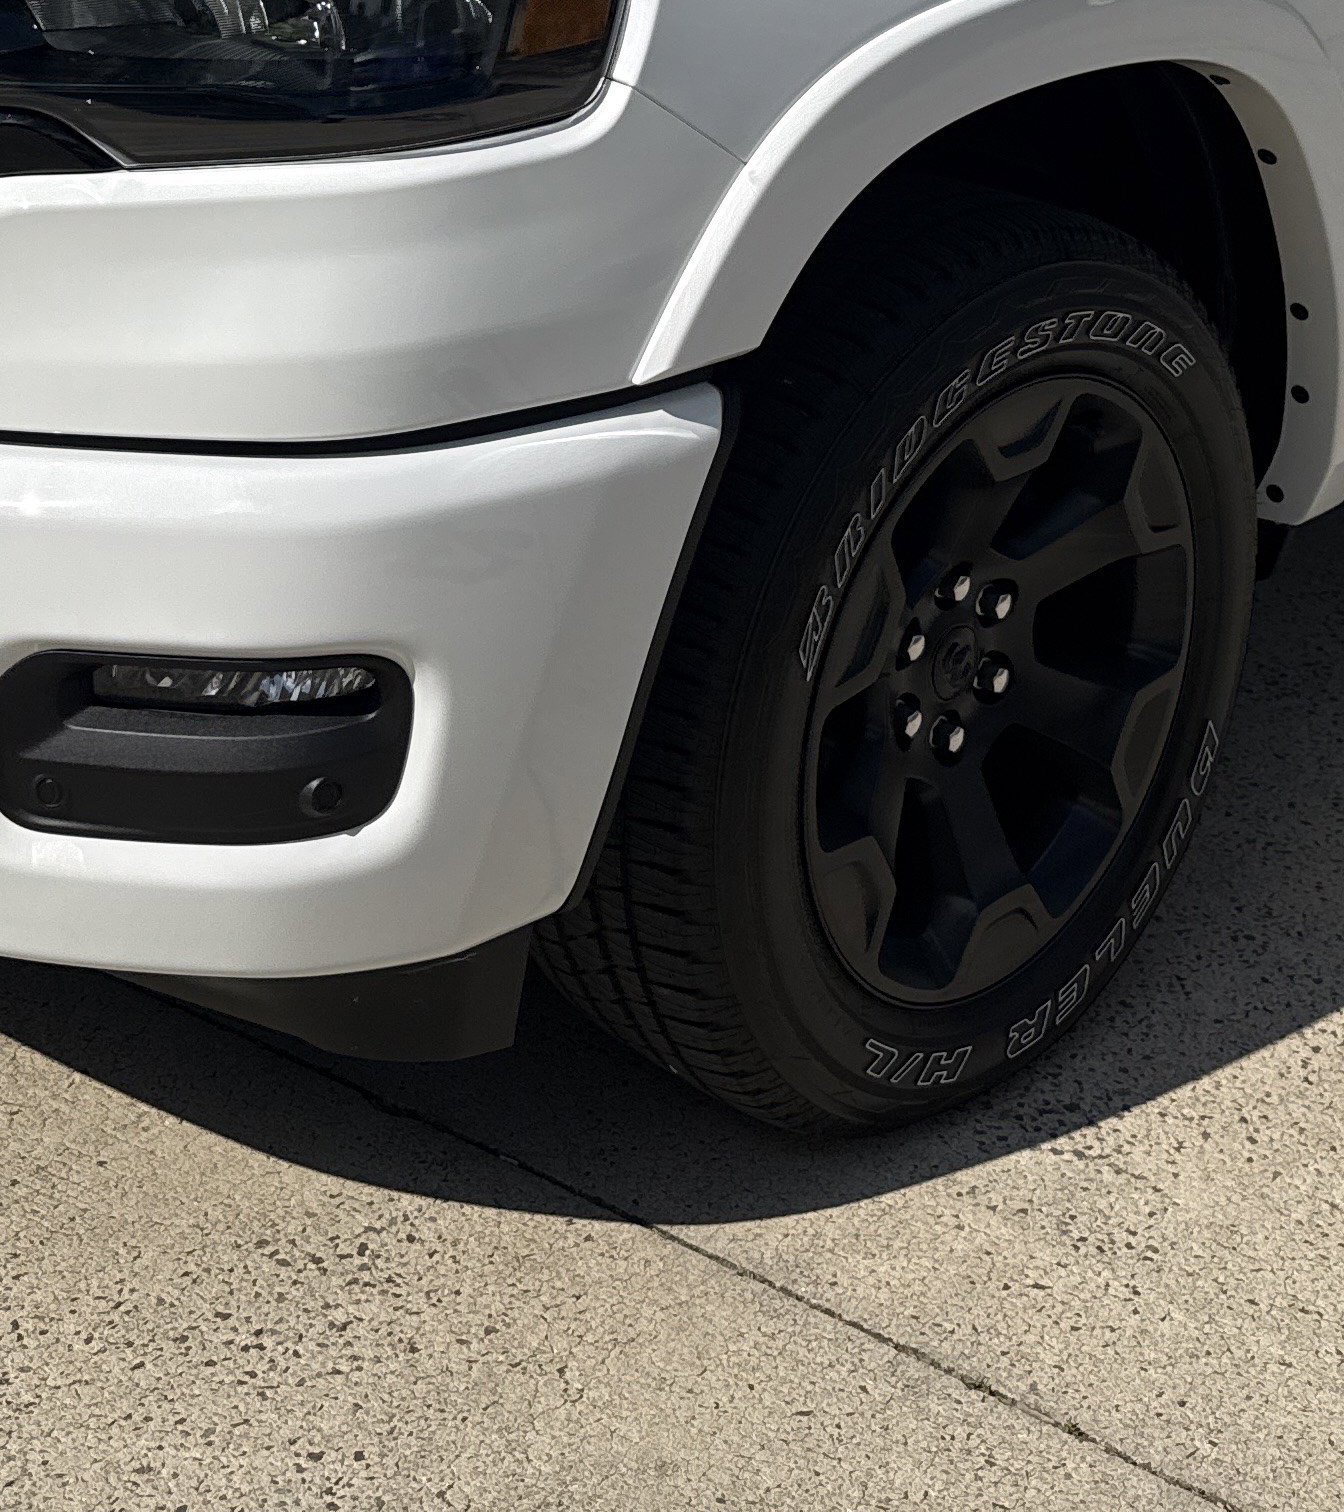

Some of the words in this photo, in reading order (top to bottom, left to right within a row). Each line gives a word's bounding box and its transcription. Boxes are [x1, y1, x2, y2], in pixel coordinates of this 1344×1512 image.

[798, 309, 1197, 682] BRIDGESTONE
[1006, 719, 1220, 1059] DUELER
[865, 1038, 973, 1087] H/L
